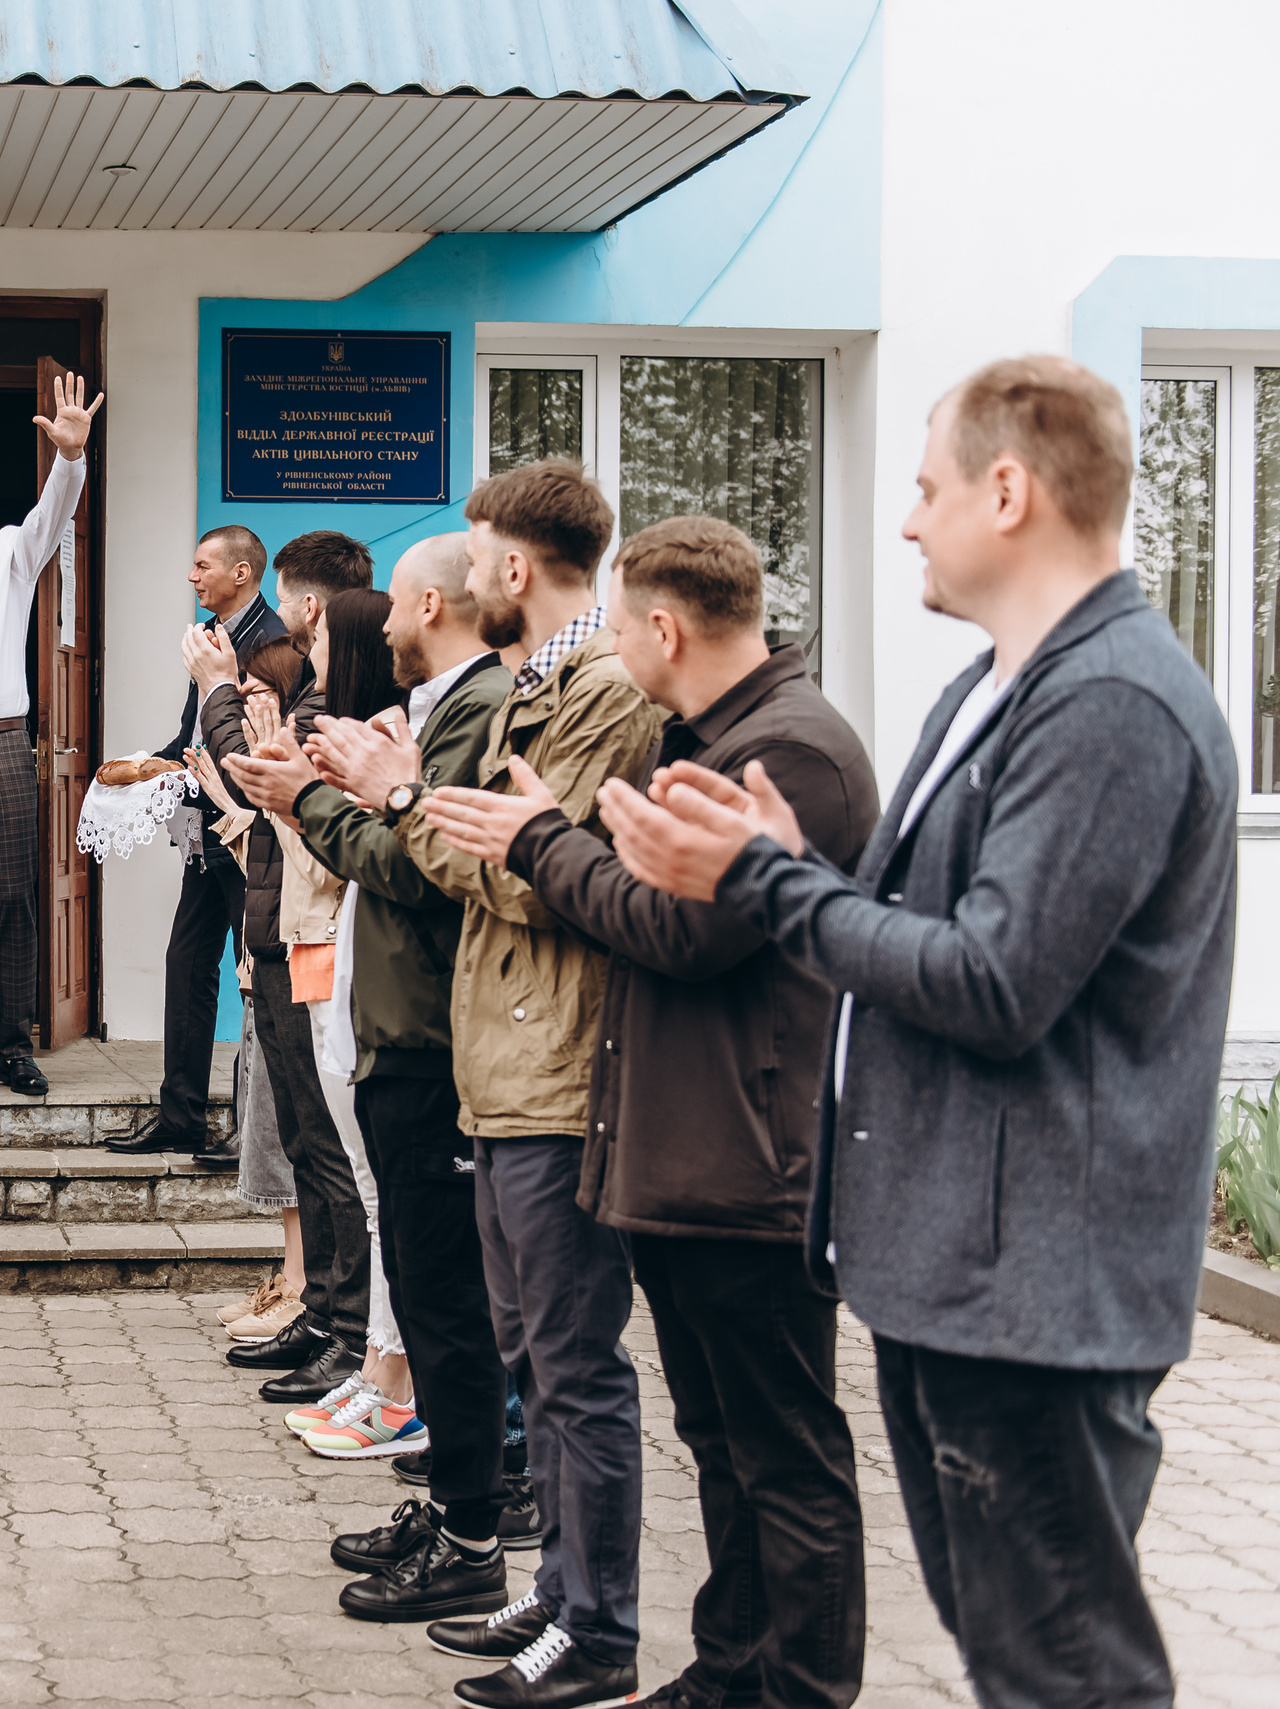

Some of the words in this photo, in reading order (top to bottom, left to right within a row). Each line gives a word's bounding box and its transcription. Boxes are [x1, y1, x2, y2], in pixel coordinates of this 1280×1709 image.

[321, 364, 352, 372] УКРАЇНА
[243, 374, 284, 383] ЗАХІДНЕ
[287, 375, 368, 384] МІЖРЕГІОНАЛЬНЕ
[370, 376, 428, 385] УПРАВЛІННЯ
[260, 383, 327, 392] МІНІСТЕРСТВА
[328, 384, 369, 394] ЮСТИЦІЇ
[279, 409, 393, 422] ЗДОЛБУНІВСЬКИЙ
[236, 429, 278, 440] ВІДДІЛ
[281, 429, 357, 442] ДЕРЖАВНОЇ
[361, 430, 435, 444] РЕЄСТРАЦІЇ
[251, 449, 289, 460] АКТІВ
[293, 450, 373, 462] ЦИВІЛЬНОГО
[377, 450, 419, 461] СТАНУ
[276, 471, 282, 479] У
[284, 471, 355, 480] РІВНЕНСЬКОМУ
[357, 471, 392, 481] РАЙОНІ
[282, 481, 343, 490] РІВНЕНСЬКОЇ
[347, 482, 385, 491] ОБЛАСТІ
